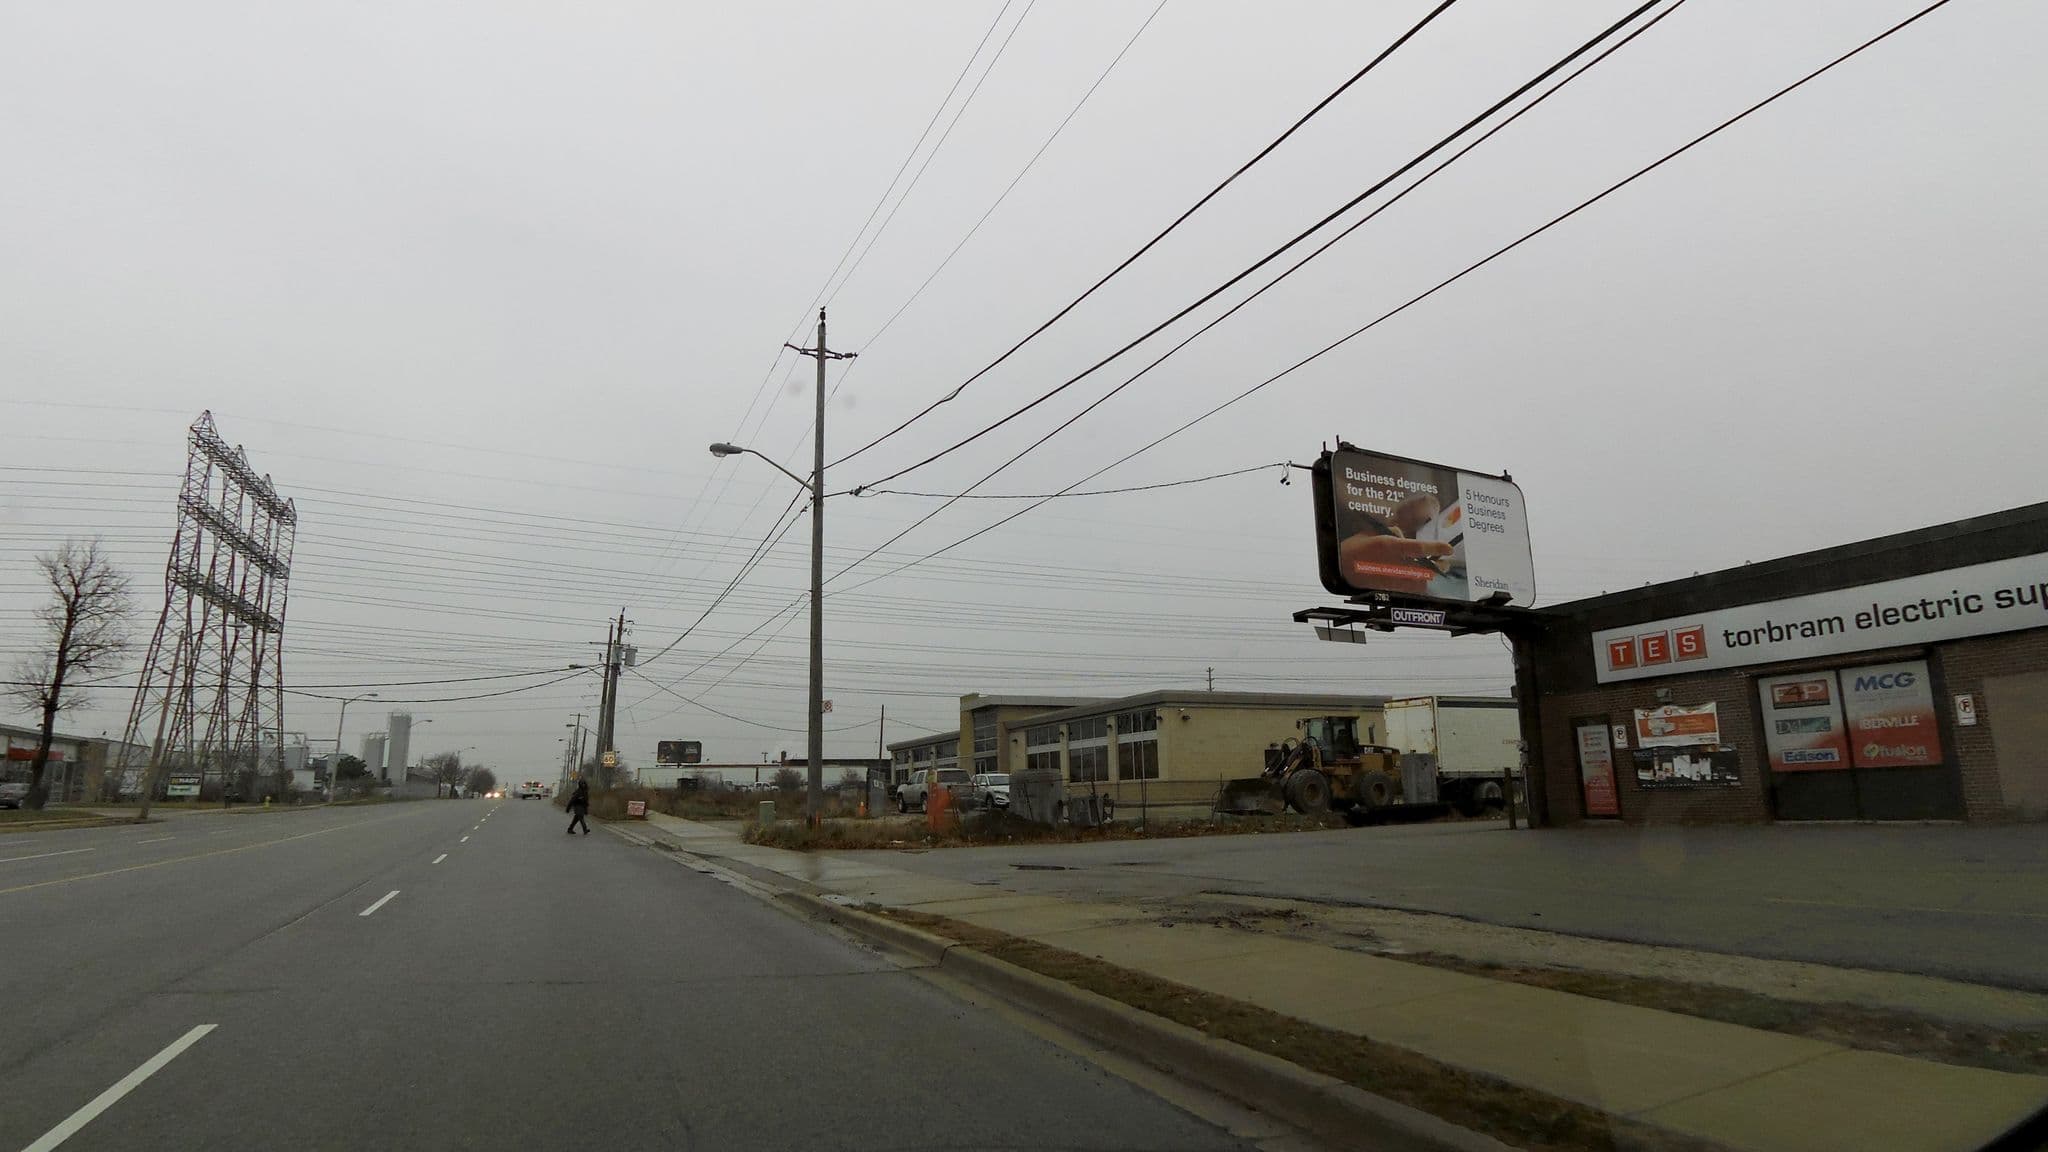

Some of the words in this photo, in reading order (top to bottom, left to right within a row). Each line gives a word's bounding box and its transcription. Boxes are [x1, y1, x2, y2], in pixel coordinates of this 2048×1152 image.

[1345, 467, 1395, 487] Business
[1397, 477, 1439, 494] degrees
[1347, 483, 1364, 496] for
[1365, 487, 1384, 500] the
[1386, 490, 1405, 502] 21st
[1465, 489, 1472, 501] 5
[1473, 491, 1510, 508] Honours
[1348, 501, 1395, 518] century.
[1467, 503, 1506, 520] Business
[1469, 517, 1505, 534] Degrees
[1474, 575, 1509, 591] Sheridan
[1393, 610, 1442, 624] OUTFRONT
[1722, 615, 1845, 648] torbram
[1855, 590, 1984, 629] electric
[1855, 672, 1916, 691] MCG
[1784, 751, 1835, 762] Edison
